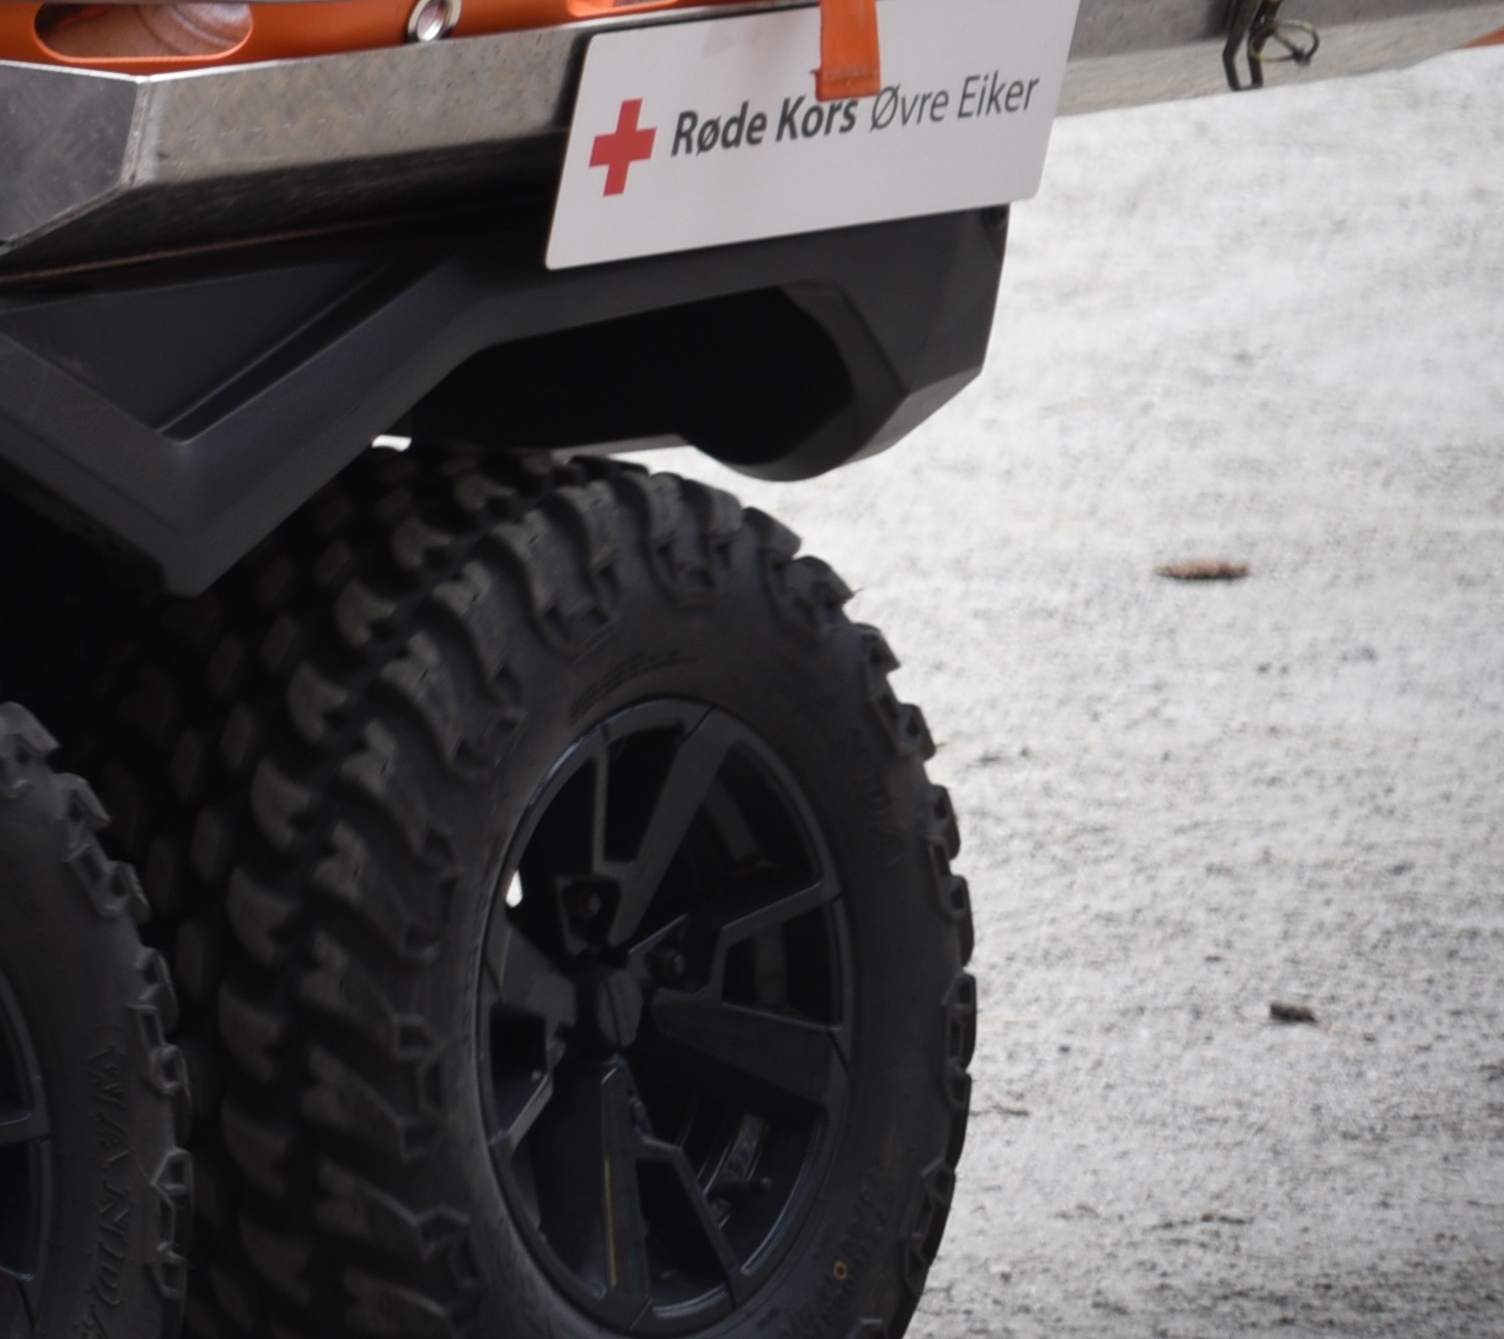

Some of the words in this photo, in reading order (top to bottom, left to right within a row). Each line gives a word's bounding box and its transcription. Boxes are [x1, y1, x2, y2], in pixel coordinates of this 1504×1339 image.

[671, 100, 768, 157] Røde
[775, 95, 859, 143] Kors
[869, 83, 950, 133] Øvre
[957, 70, 1040, 119] Eiker
